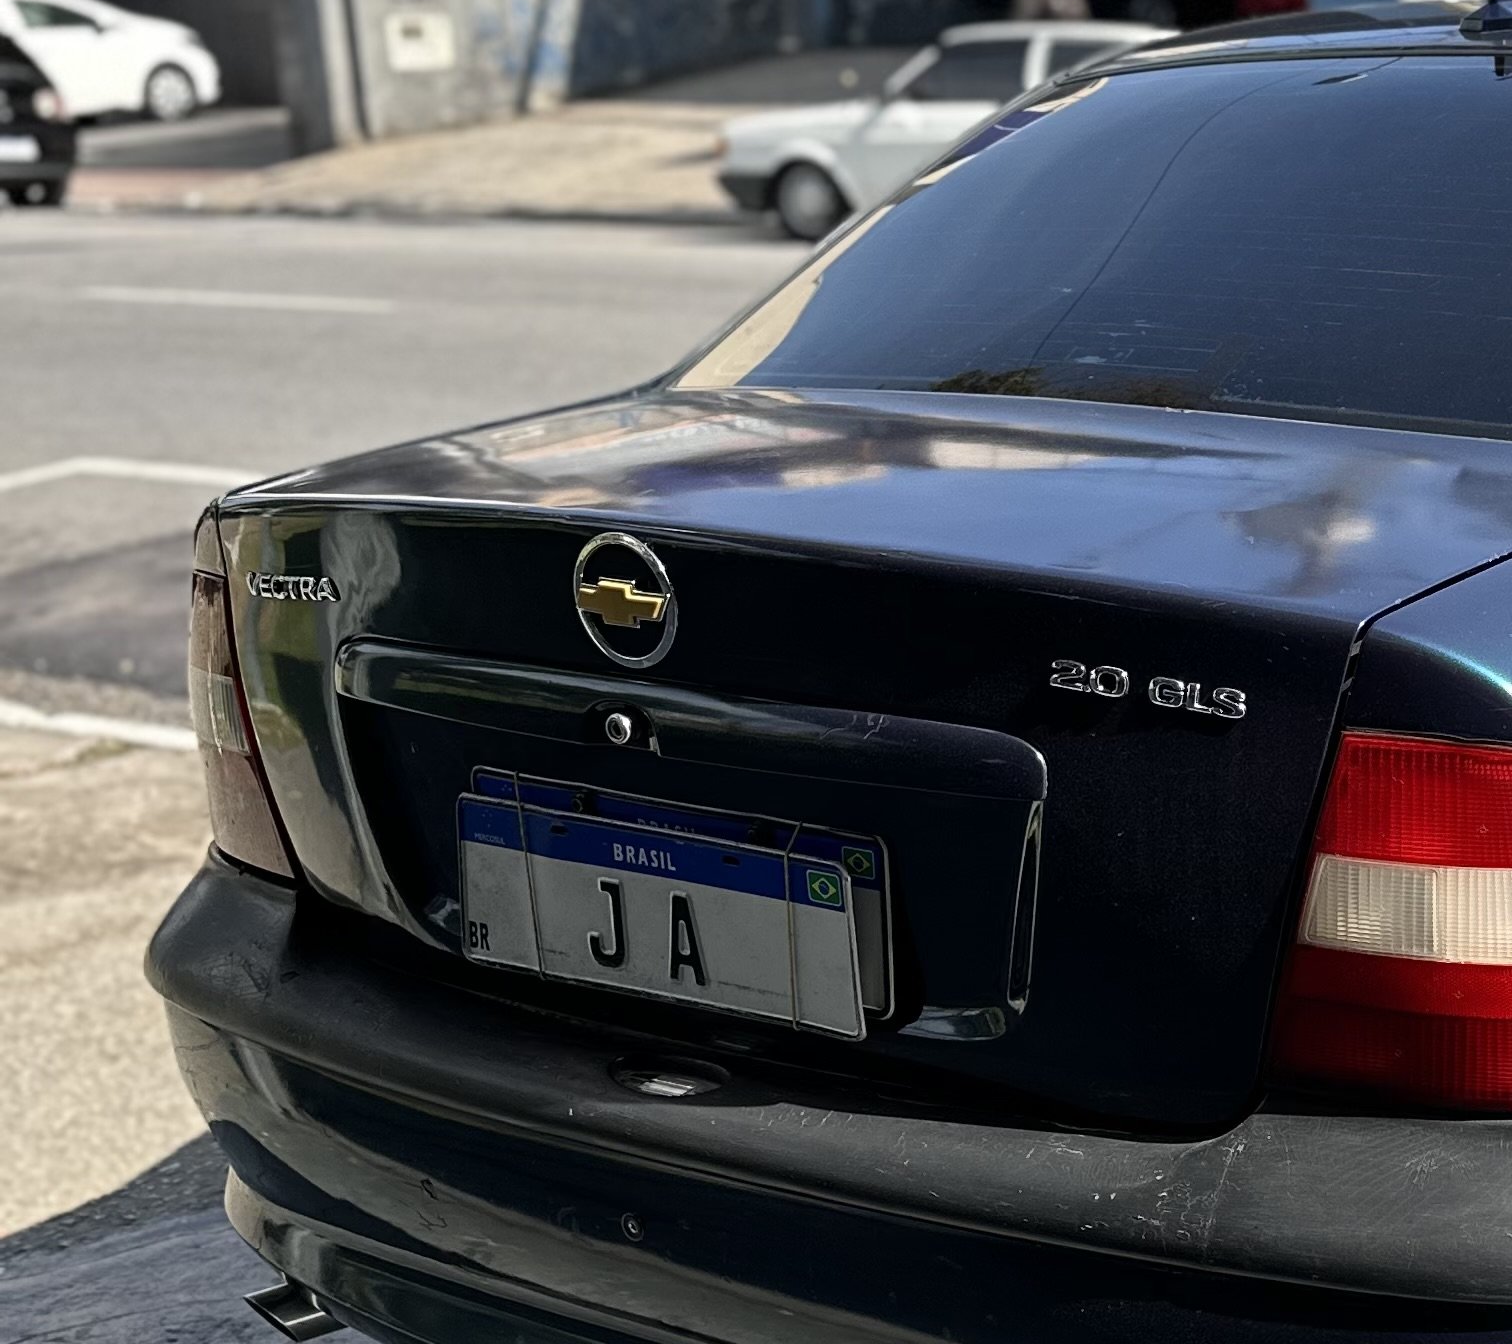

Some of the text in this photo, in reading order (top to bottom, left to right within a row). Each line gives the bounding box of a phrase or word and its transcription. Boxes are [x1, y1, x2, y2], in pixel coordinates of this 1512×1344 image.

[245, 571, 337, 602] VECTRA
[1148, 676, 1247, 719] GLS
[614, 844, 676, 871] BRASIL
[470, 921, 490, 951] BR
